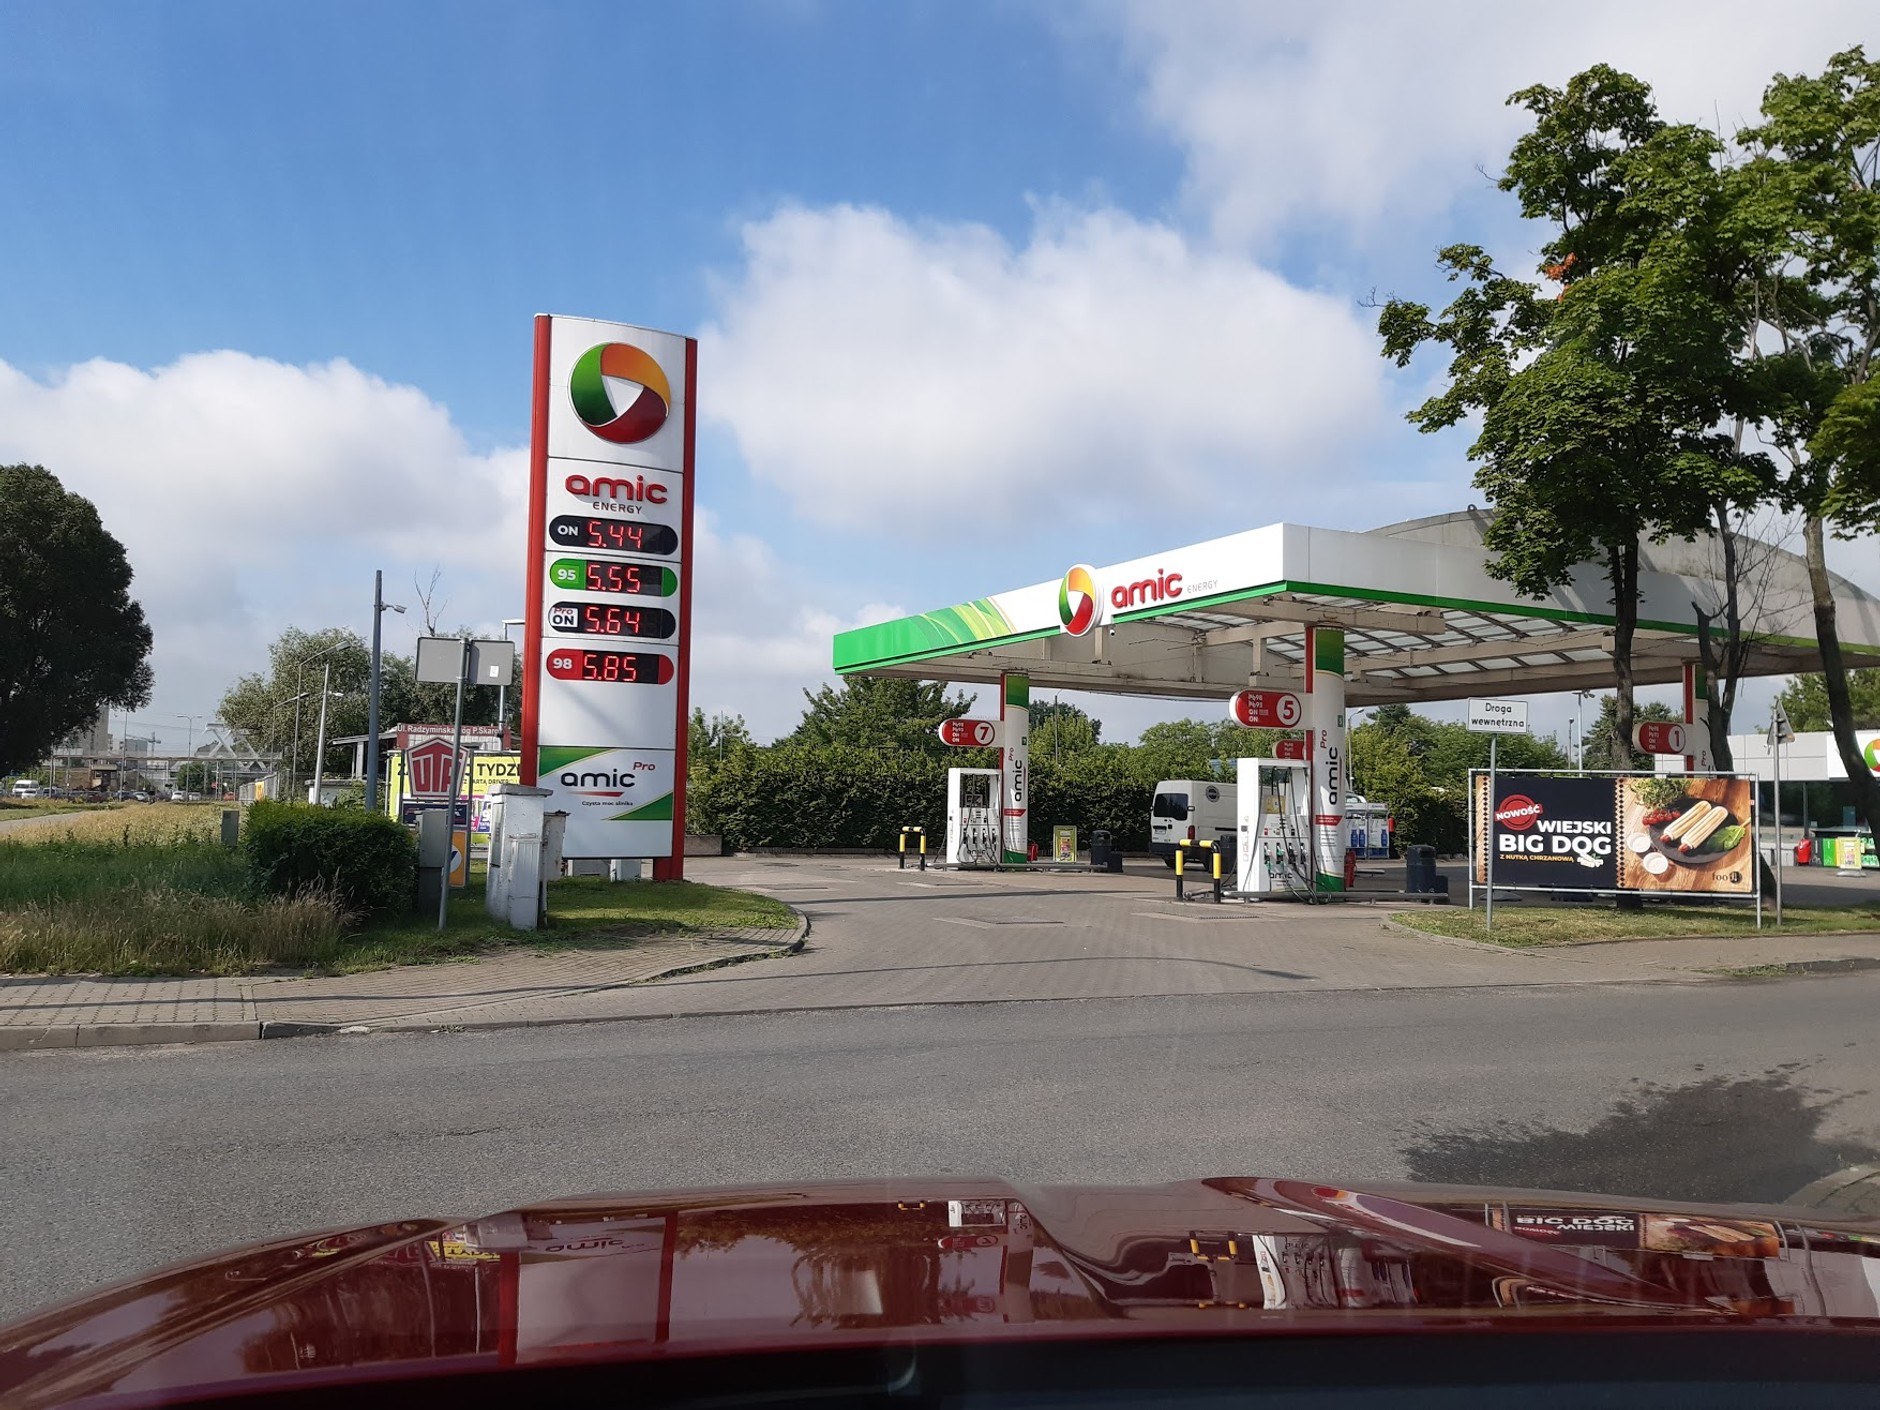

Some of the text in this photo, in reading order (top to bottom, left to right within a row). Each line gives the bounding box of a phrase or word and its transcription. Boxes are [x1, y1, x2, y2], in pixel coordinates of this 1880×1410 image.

[565, 474, 668, 505] amic
[592, 501, 643, 514] ENERGY
[557, 520, 642, 549] ON 5.44
[557, 564, 641, 593] 95 5.55
[1111, 568, 1219, 609] amic ENERGY
[552, 606, 641, 634] ON 5.64
[553, 606, 575, 615] Pro
[553, 654, 637, 682] 98 5.85
[1283, 700, 1295, 720] 5
[1485, 703, 1512, 715] Droga
[979, 726, 990, 740] 7
[1471, 717, 1525, 729] wewnętrzna
[1674, 730, 1680, 747] 1
[560, 761, 656, 788] amic Pro
[1012, 759, 1022, 802] amic
[1326, 747, 1337, 805] amic
[1495, 804, 1541, 821] NOWOŚĆ
[1536, 820, 1612, 834] WIEJSKI
[1499, 834, 1612, 855] BIG DOG
